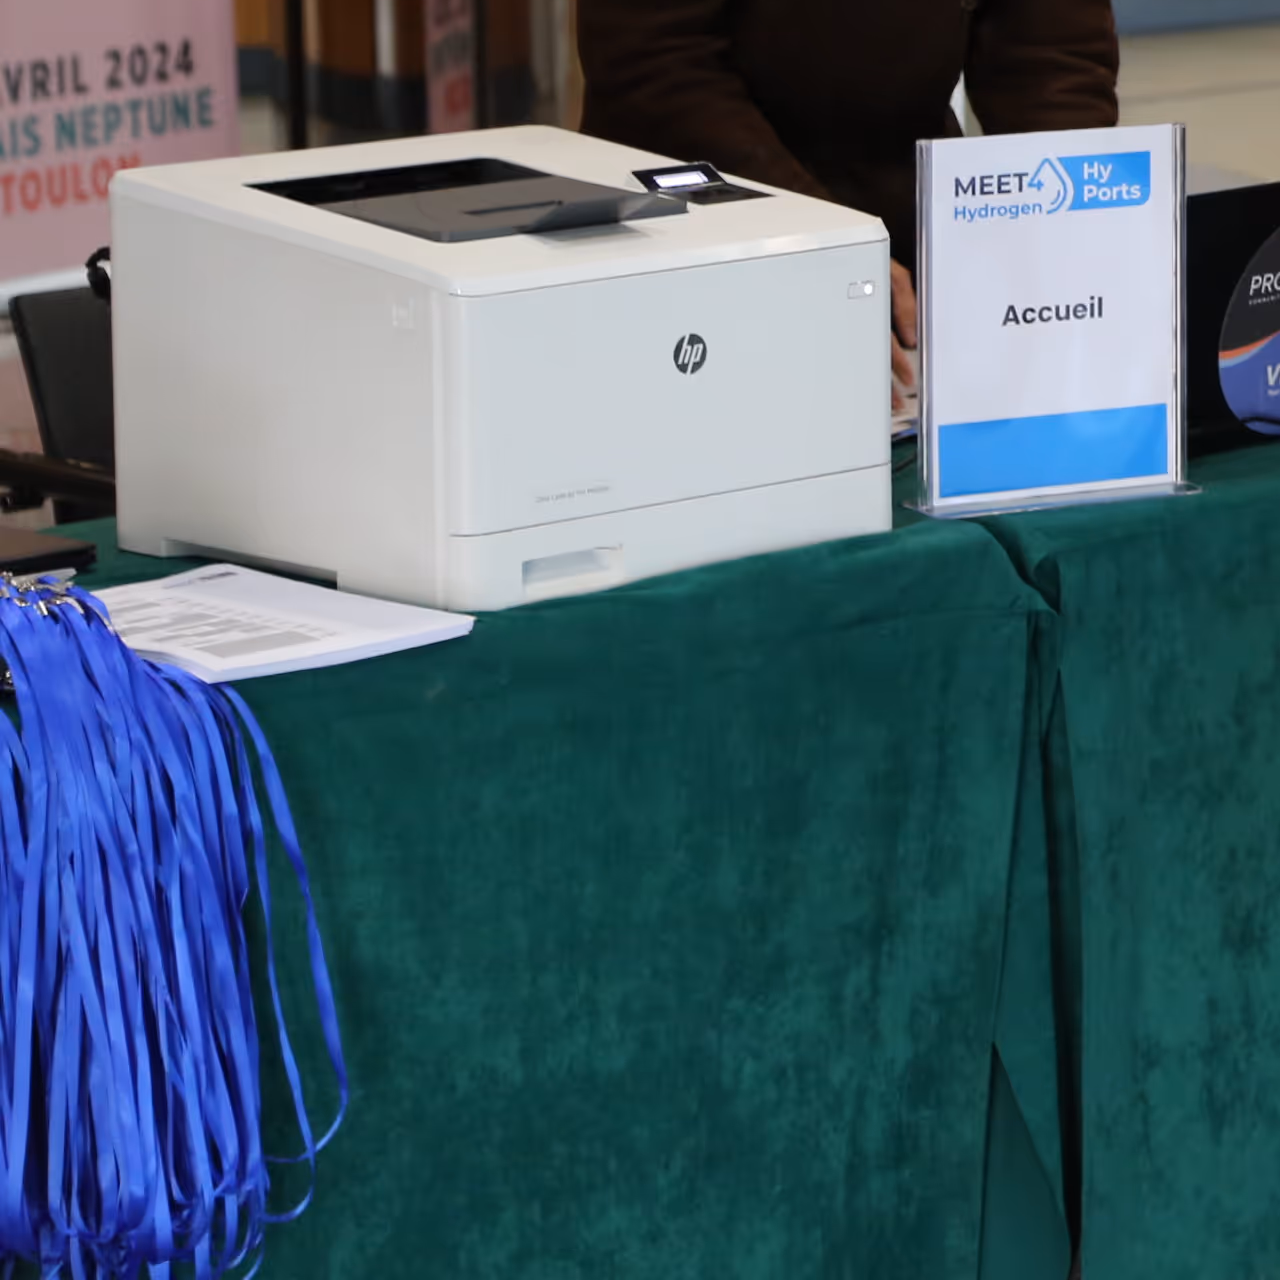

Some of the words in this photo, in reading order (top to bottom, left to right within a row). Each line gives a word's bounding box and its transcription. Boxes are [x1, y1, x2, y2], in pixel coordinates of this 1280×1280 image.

[105, 37, 194, 90] 2024
[55, 82, 214, 152] NEPTUNE
[1082, 161, 1112, 183] Hy
[1082, 183, 1142, 202] Ports
[953, 202, 1043, 223] Hydrogen
[1001, 294, 1103, 327] Accueil
[676, 333, 705, 375] hp
